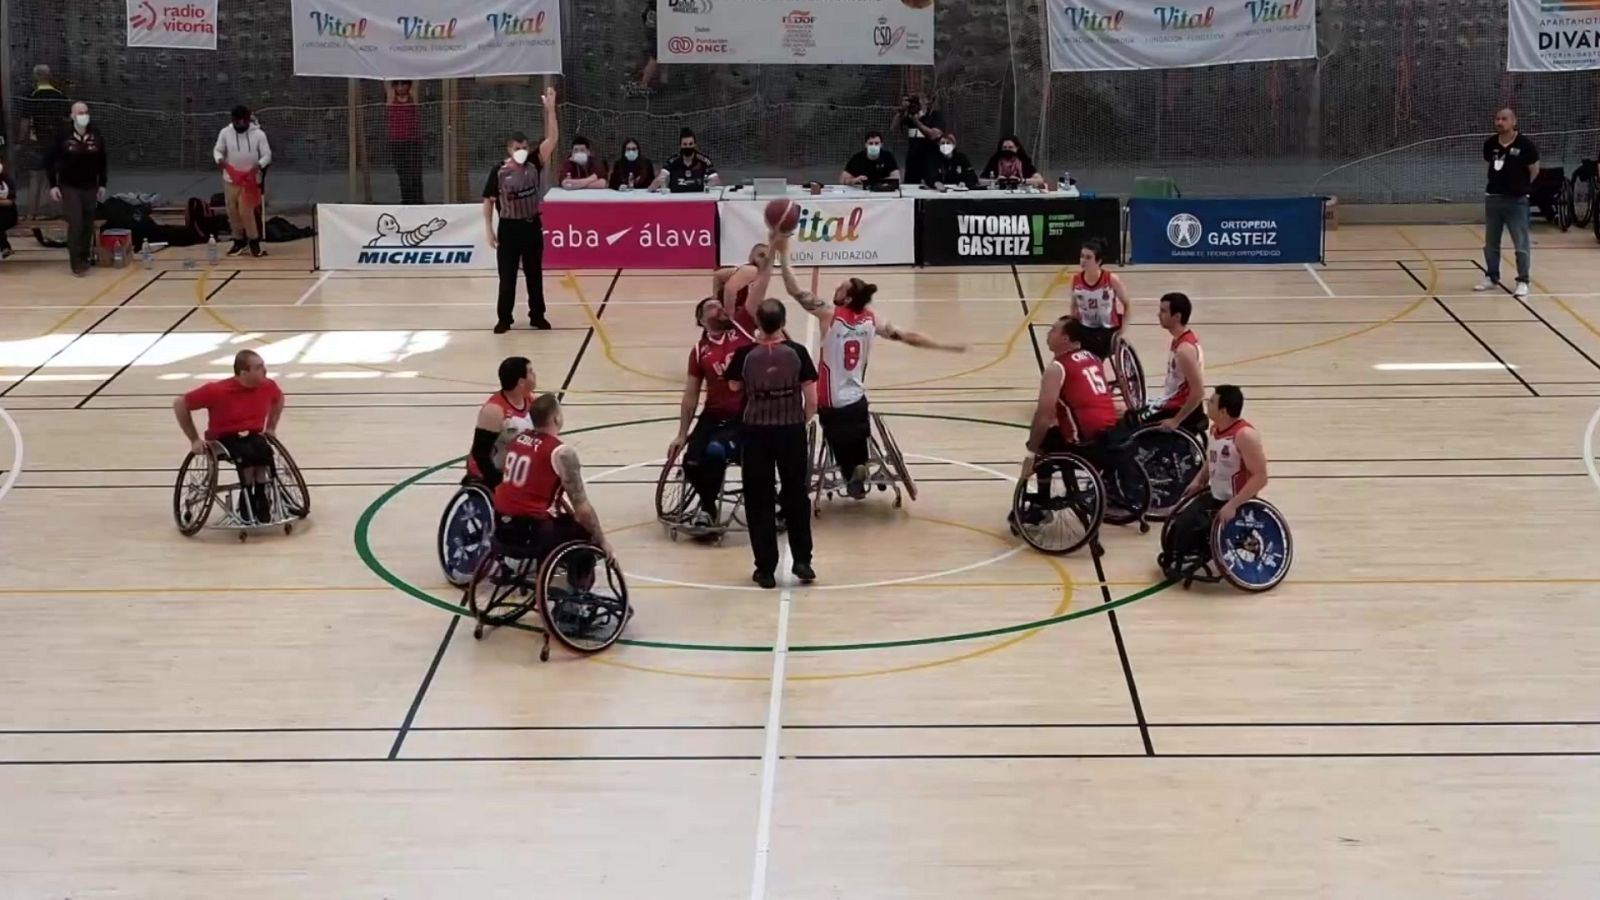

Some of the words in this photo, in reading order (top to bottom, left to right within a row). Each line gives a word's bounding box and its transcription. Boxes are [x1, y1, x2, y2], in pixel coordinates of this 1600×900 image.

[163, 4, 205, 18] radio
[1065, 7, 1124, 31] Vital
[1154, 6, 1215, 31] Vital
[1244, 0, 1303, 24] Vital
[163, 18, 214, 34] vitoria
[310, 11, 367, 39] Vital
[397, 16, 458, 40] Vital
[486, 11, 545, 37] Vital
[1540, 18, 1600, 27] APARTAHOT
[873, 26, 892, 46] CSD
[696, 45, 728, 53] ONCE
[542, 224, 599, 247] raba
[639, 223, 711, 247] álava
[797, 207, 863, 242] ital
[957, 214, 1030, 235] VITORIA
[1220, 220, 1277, 230] ORTOPEDIA
[957, 236, 1030, 256] GASTEIZ
[1208, 232, 1277, 246] GASTEIZ
[357, 251, 473, 264] MICHELIN
[820, 251, 879, 261] FUNDAZIOA
[1088, 298, 1098, 309] 21
[843, 340, 860, 371] 8
[1082, 365, 1107, 395] 15
[503, 451, 531, 487] 90
